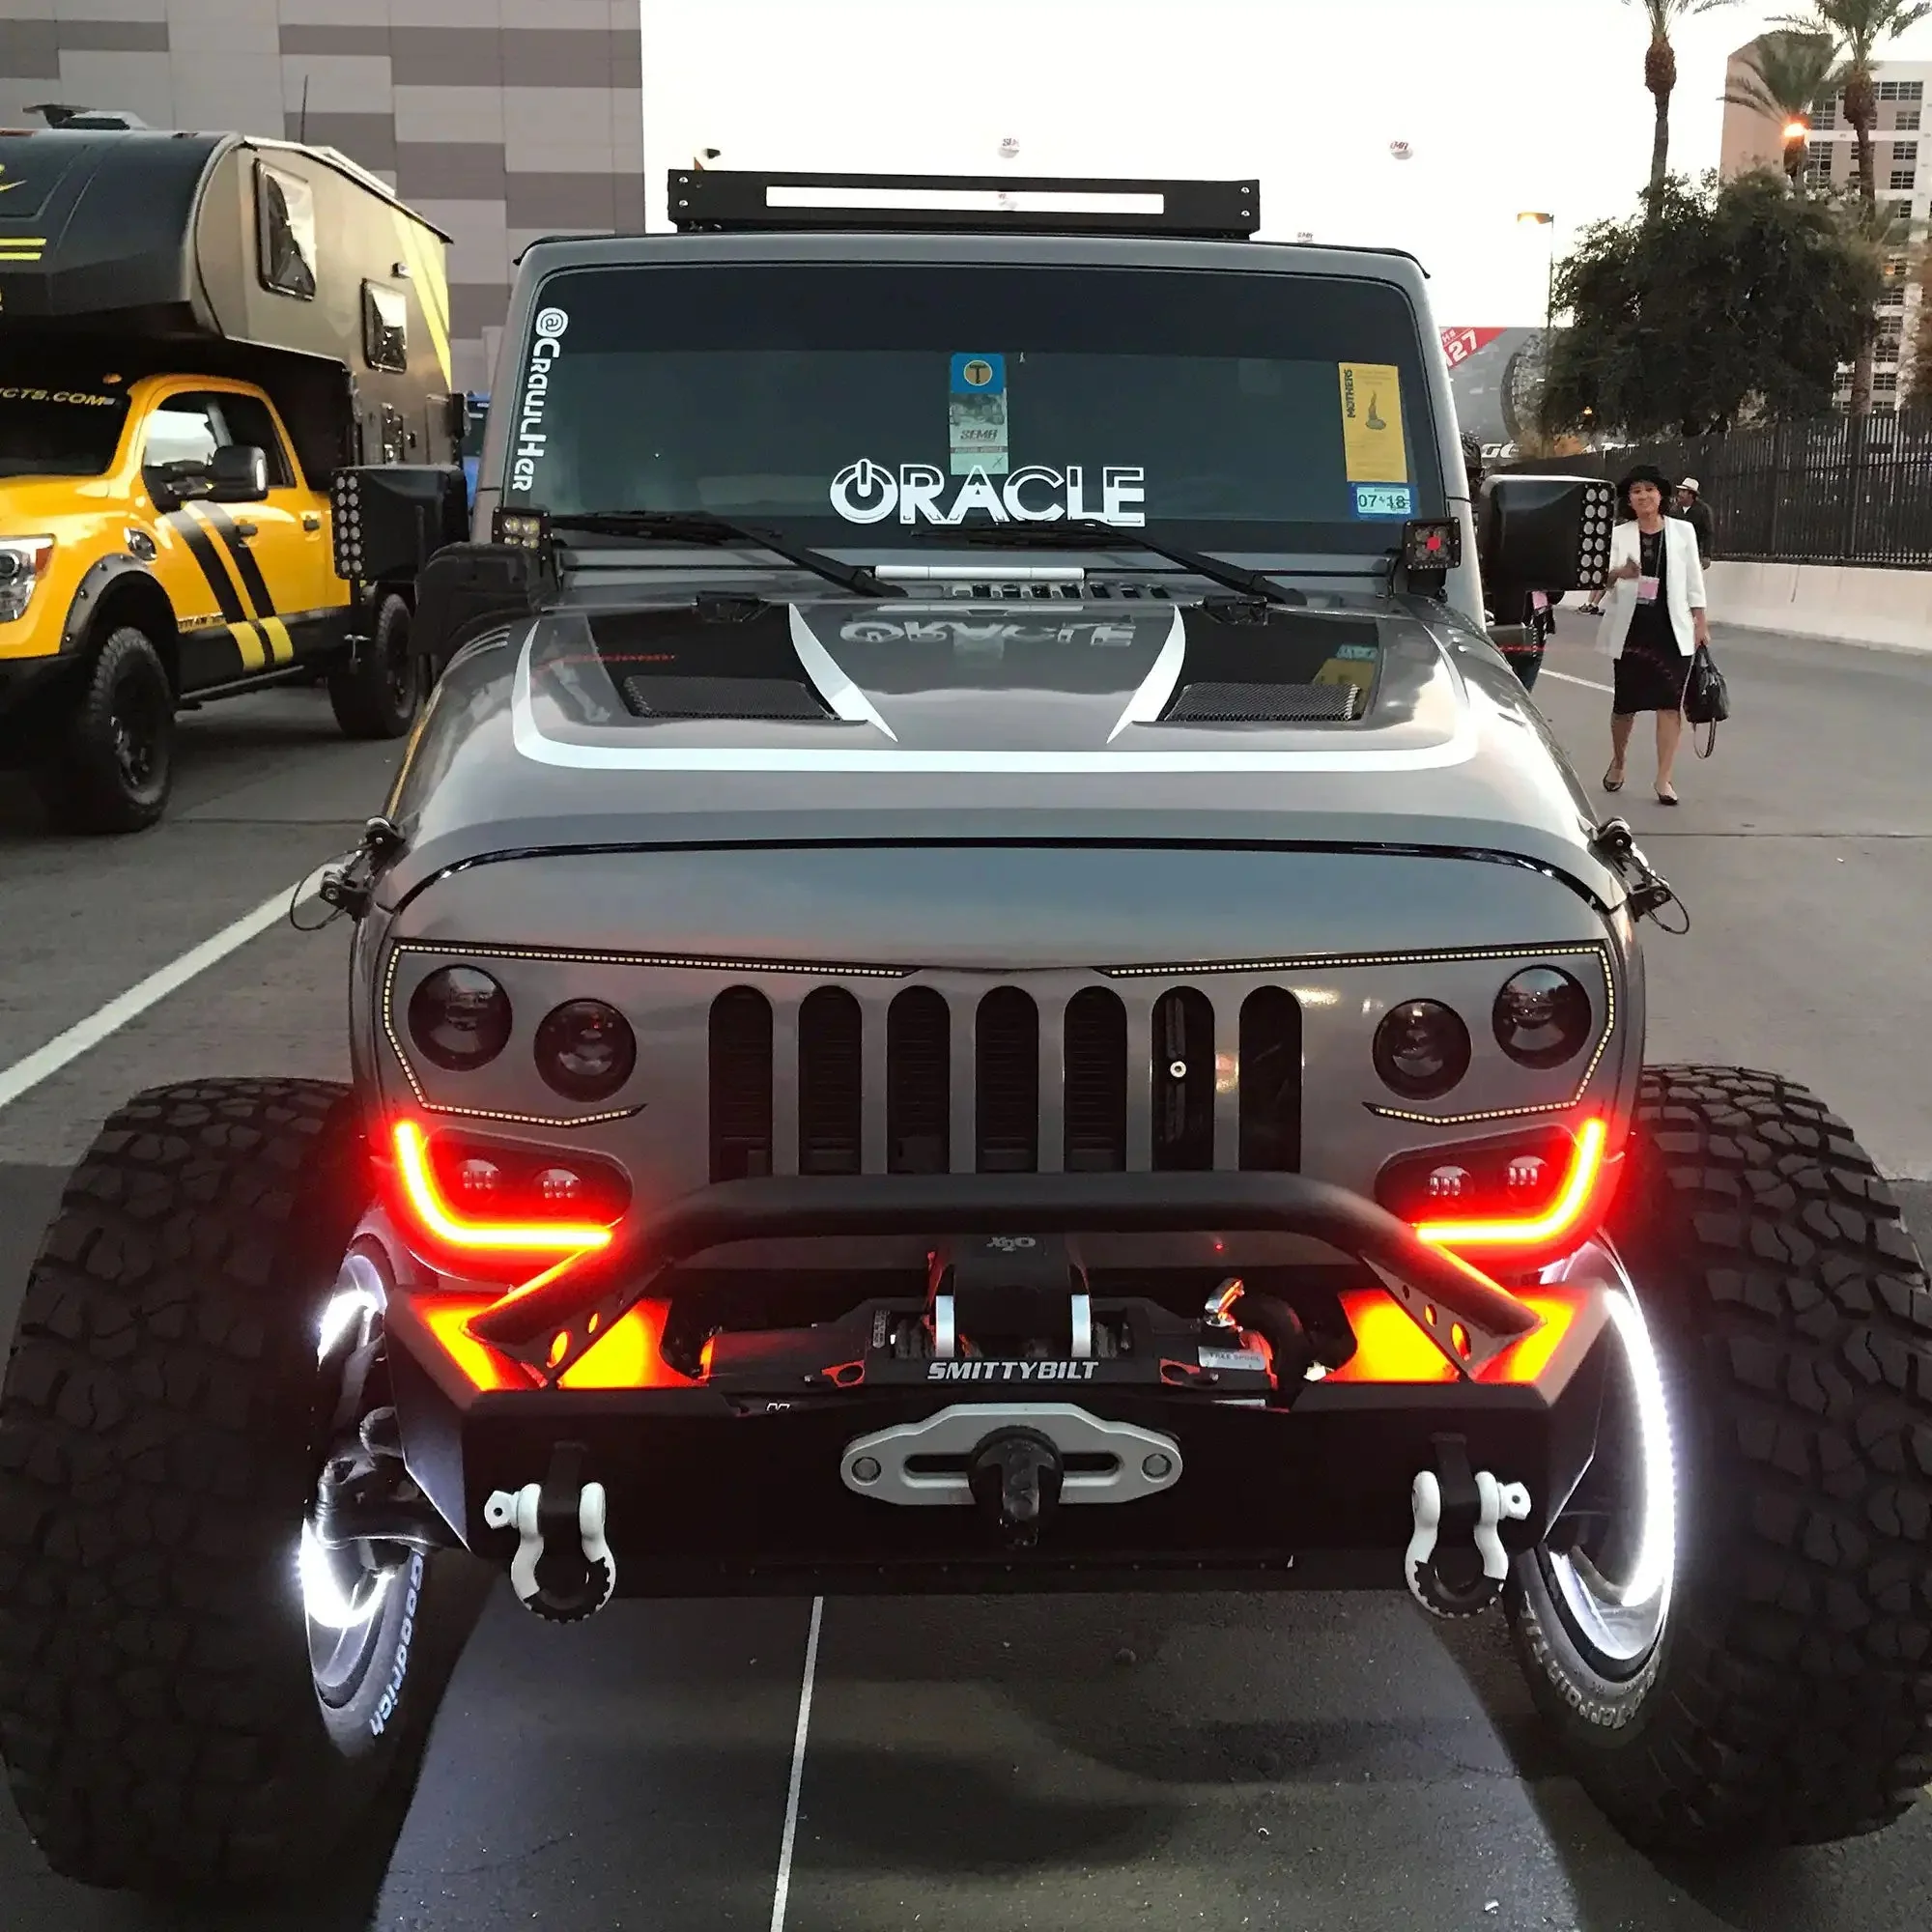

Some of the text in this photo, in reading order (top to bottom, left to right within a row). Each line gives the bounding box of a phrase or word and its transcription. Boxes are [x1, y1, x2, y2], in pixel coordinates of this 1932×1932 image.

[0, 387, 107, 406] CTS.COM
[830, 458, 1146, 526] ORACLE
[927, 1361, 1099, 1380] SMITTYBILT
